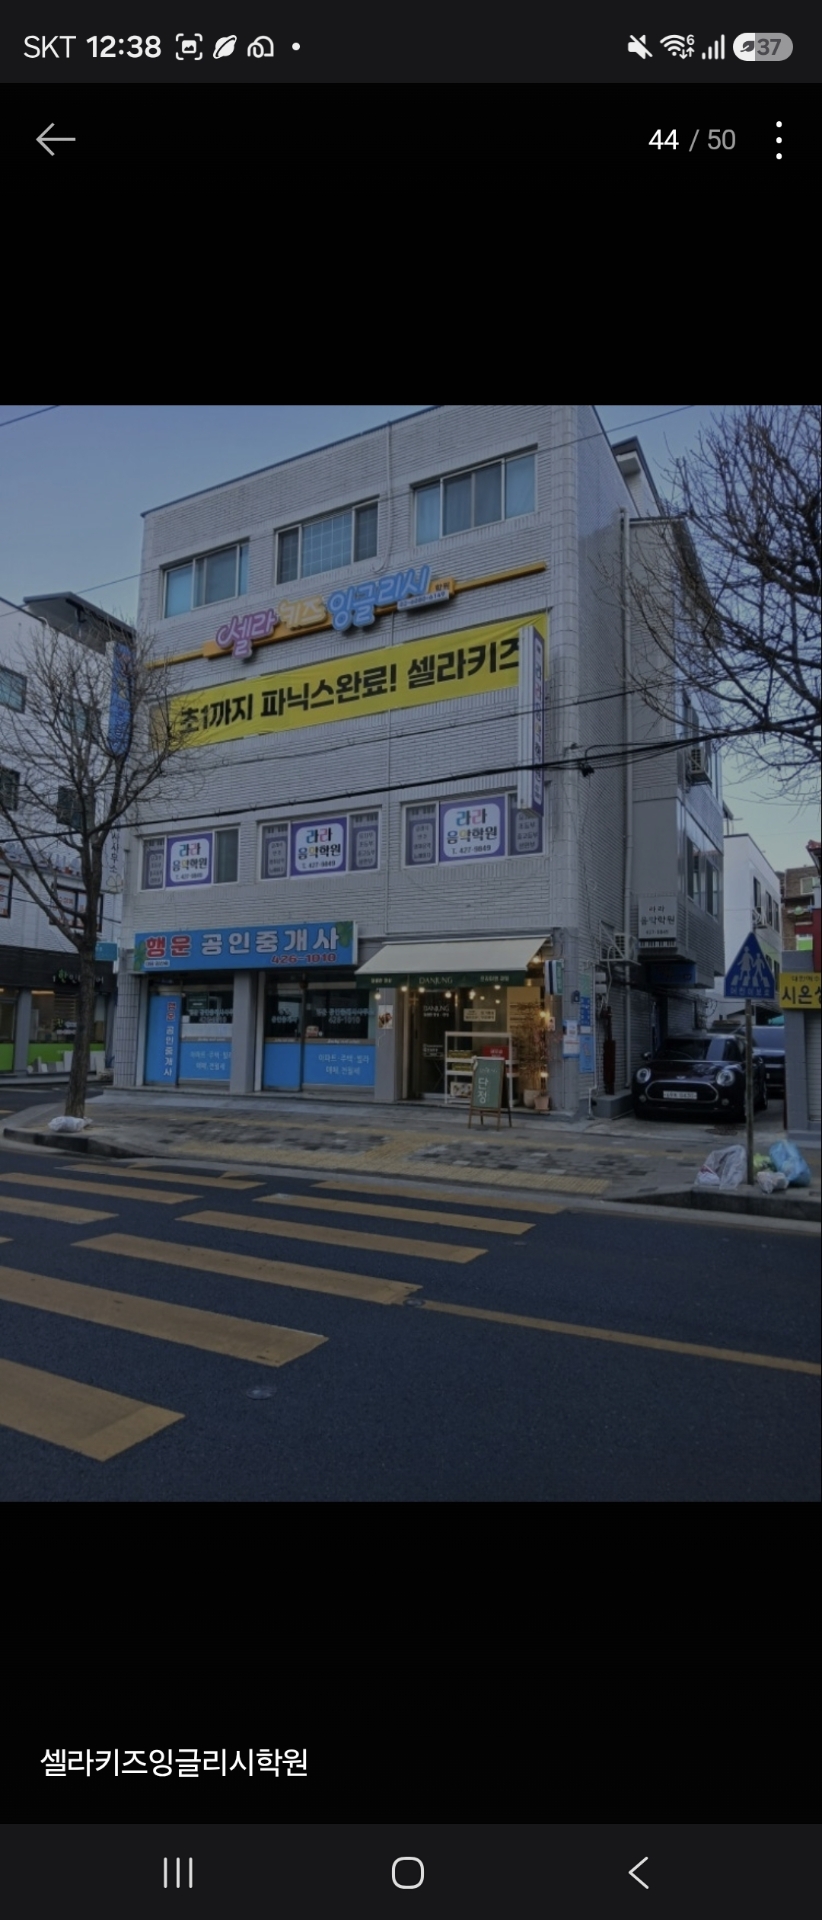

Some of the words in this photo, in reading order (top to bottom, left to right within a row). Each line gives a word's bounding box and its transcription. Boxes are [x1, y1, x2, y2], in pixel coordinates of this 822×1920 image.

[260, 663, 397, 717] 파닉스완료!
[455, 808, 487, 826] 라라
[306, 827, 333, 844] 라라
[446, 825, 497, 844] 음악학원
[179, 842, 201, 857] 라라
[298, 843, 341, 861] 음악학원
[172, 857, 208, 872] 음악학원
[145, 935, 191, 959] 행운
[202, 927, 339, 956] 공인중개사
[270, 954, 337, 965] 426-1010
[419, 976, 453, 985] DANJUNG
